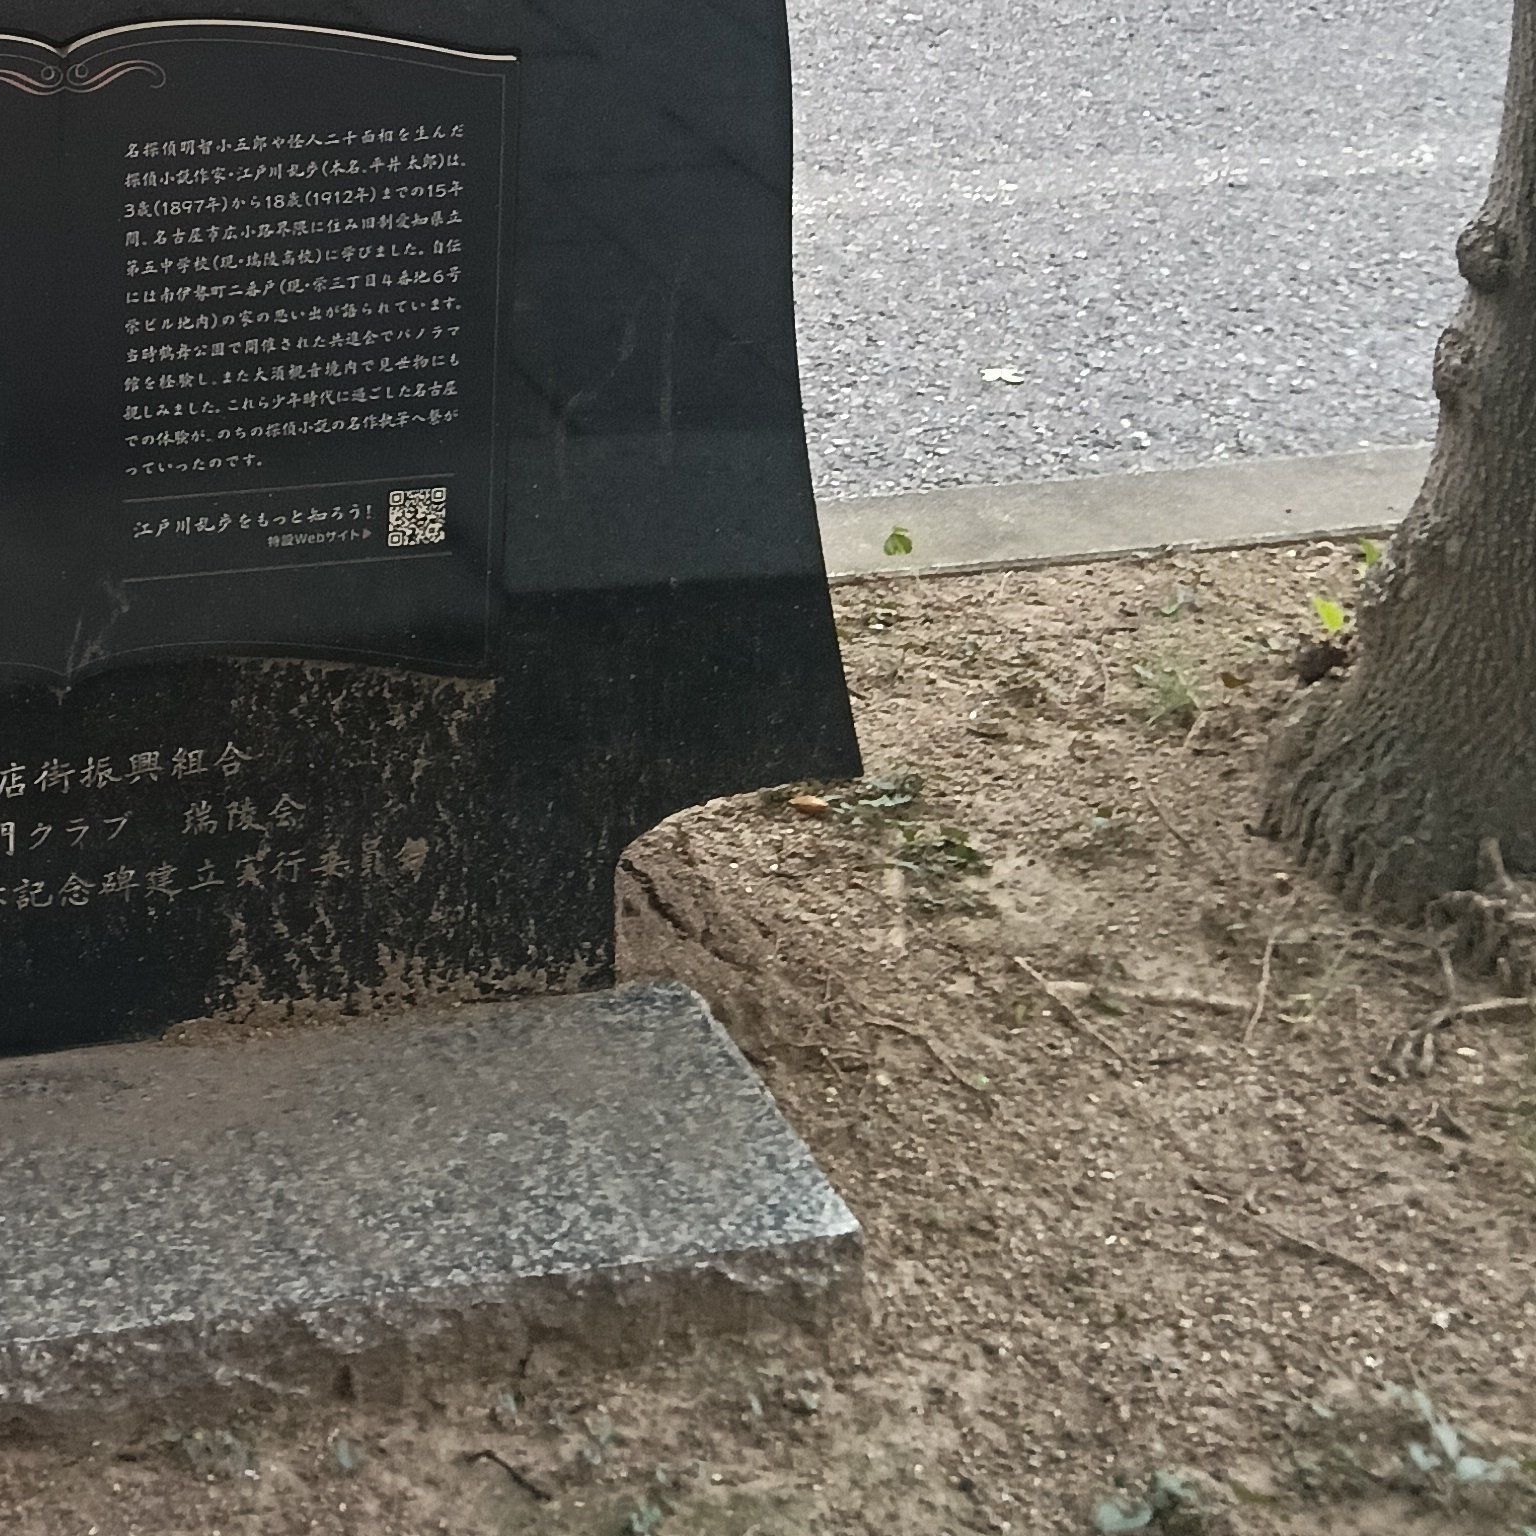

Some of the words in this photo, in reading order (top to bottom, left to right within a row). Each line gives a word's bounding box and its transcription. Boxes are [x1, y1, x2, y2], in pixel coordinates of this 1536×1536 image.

[125, 454, 262, 475] っていったのです。
[182, 793, 306, 834] 瑞陵会
